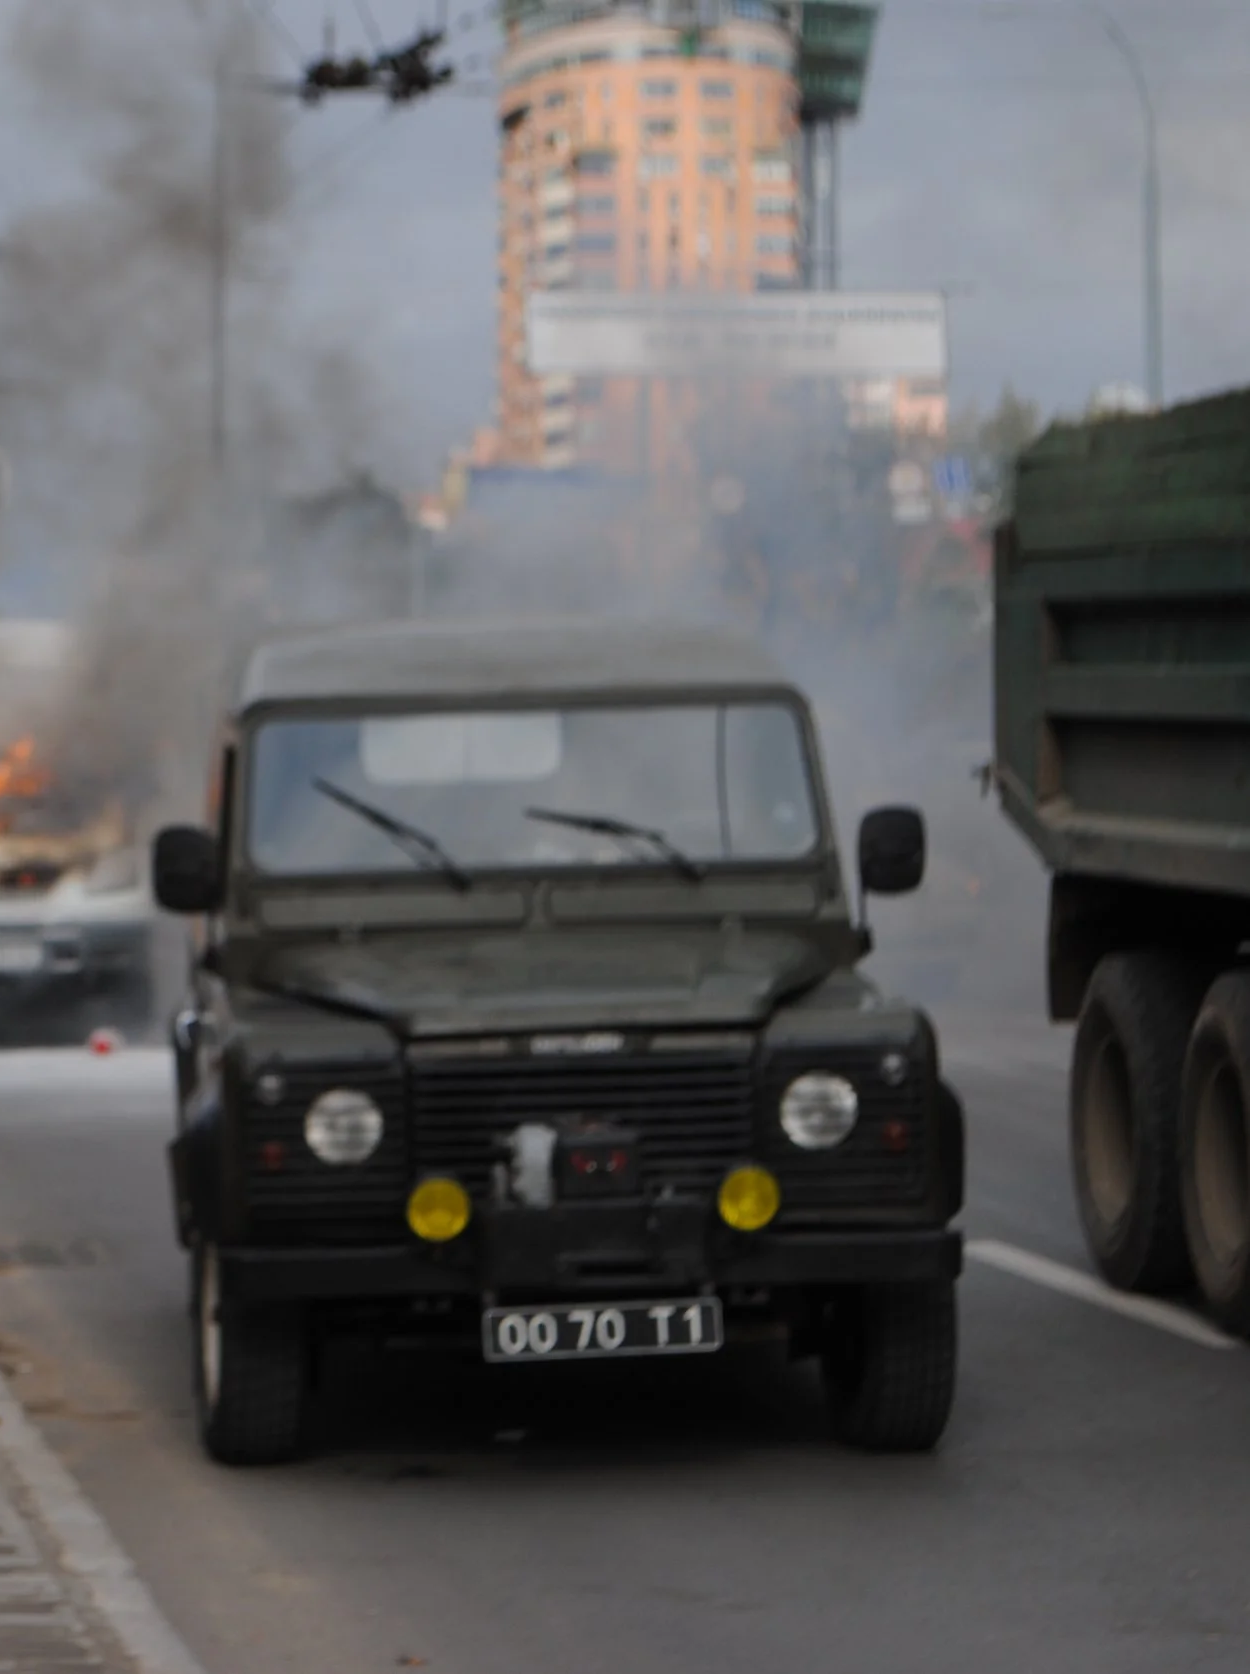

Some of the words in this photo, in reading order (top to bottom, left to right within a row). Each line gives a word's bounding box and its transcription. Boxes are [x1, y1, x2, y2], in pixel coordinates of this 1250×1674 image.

[498, 1312, 558, 1355] 00
[567, 1308, 626, 1351] 70
[648, 1303, 704, 1347] T1
